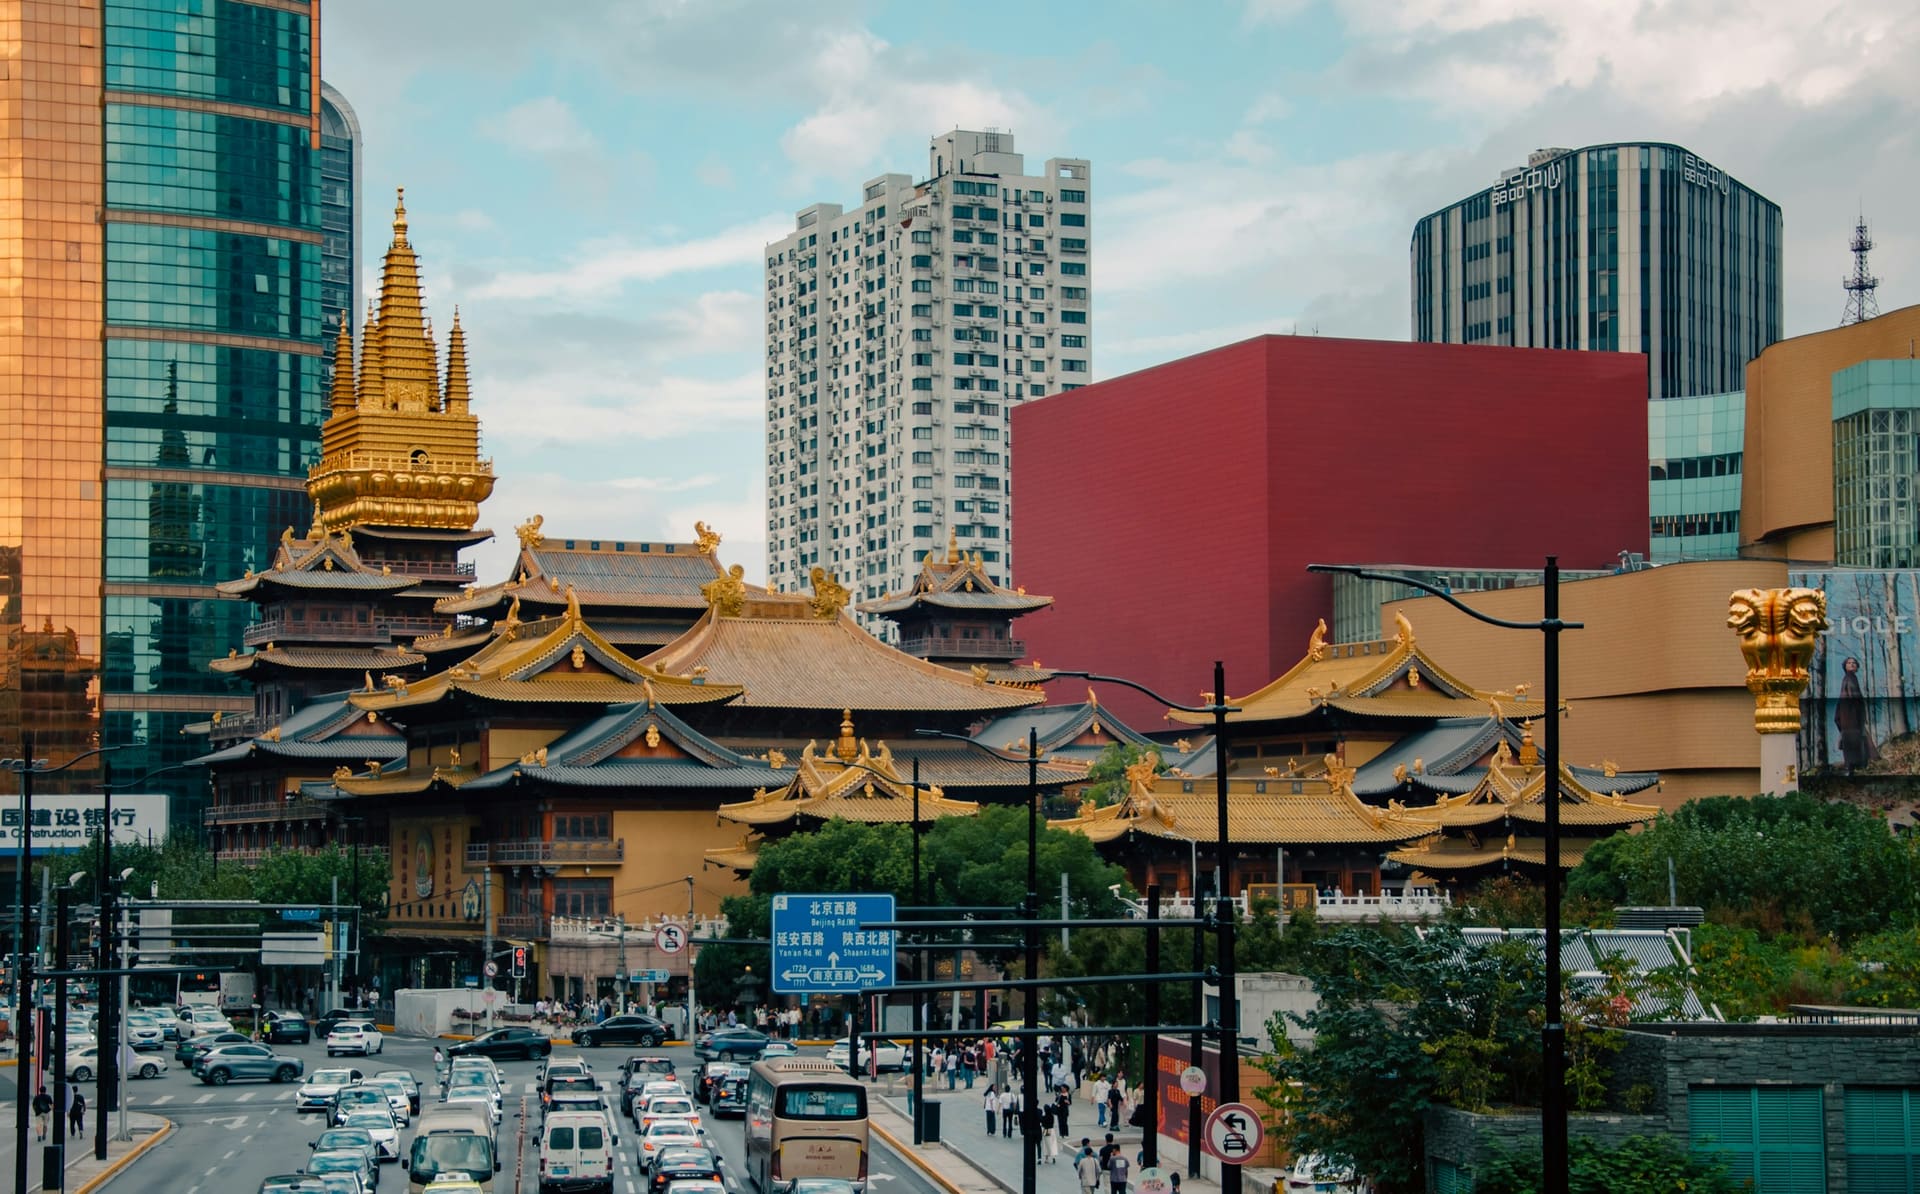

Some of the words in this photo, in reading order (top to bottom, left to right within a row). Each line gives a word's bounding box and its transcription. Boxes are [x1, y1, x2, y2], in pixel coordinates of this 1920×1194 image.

[1, 807, 136, 826] 国建设银行
[810, 901, 857, 916] 北京西路
[811, 918, 836, 928] Beijing
[776, 931, 825, 946] 延安西路
[842, 931, 890, 946] 陕西北路
[813, 969, 854, 981] 南京西路
